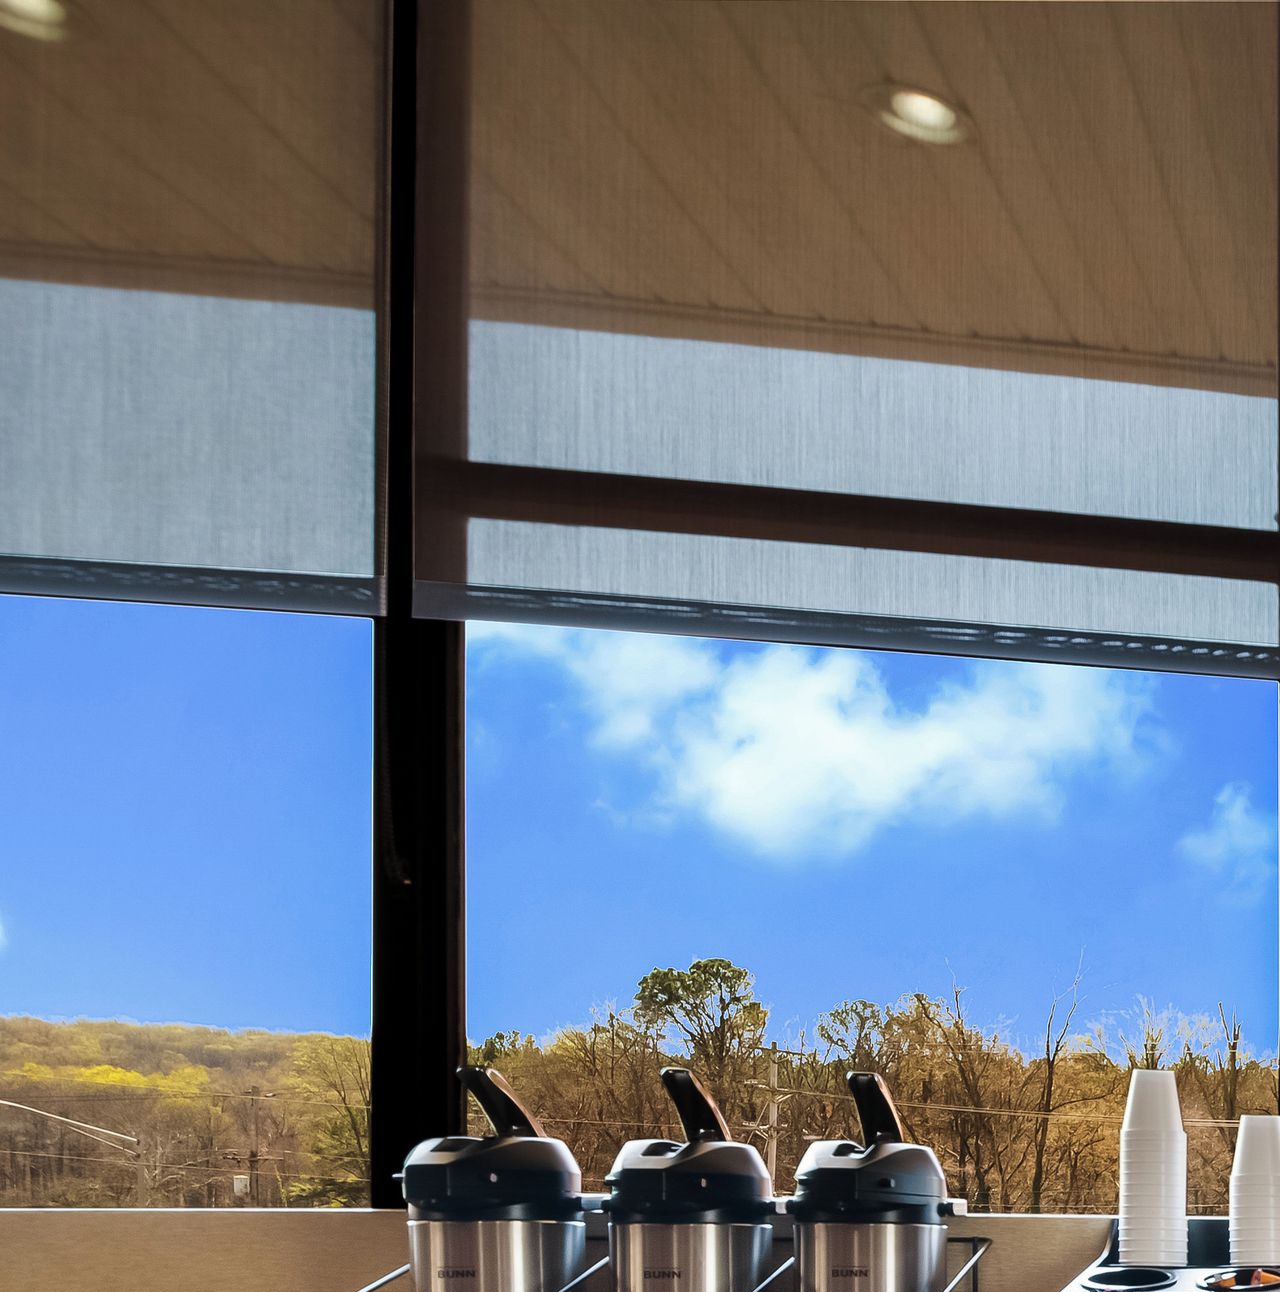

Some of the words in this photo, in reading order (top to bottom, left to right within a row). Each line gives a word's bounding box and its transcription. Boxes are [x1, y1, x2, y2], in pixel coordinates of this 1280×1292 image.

[437, 1268, 476, 1279] BUNN
[643, 1269, 681, 1280] BUNN
[831, 1268, 869, 1278] BUNN
